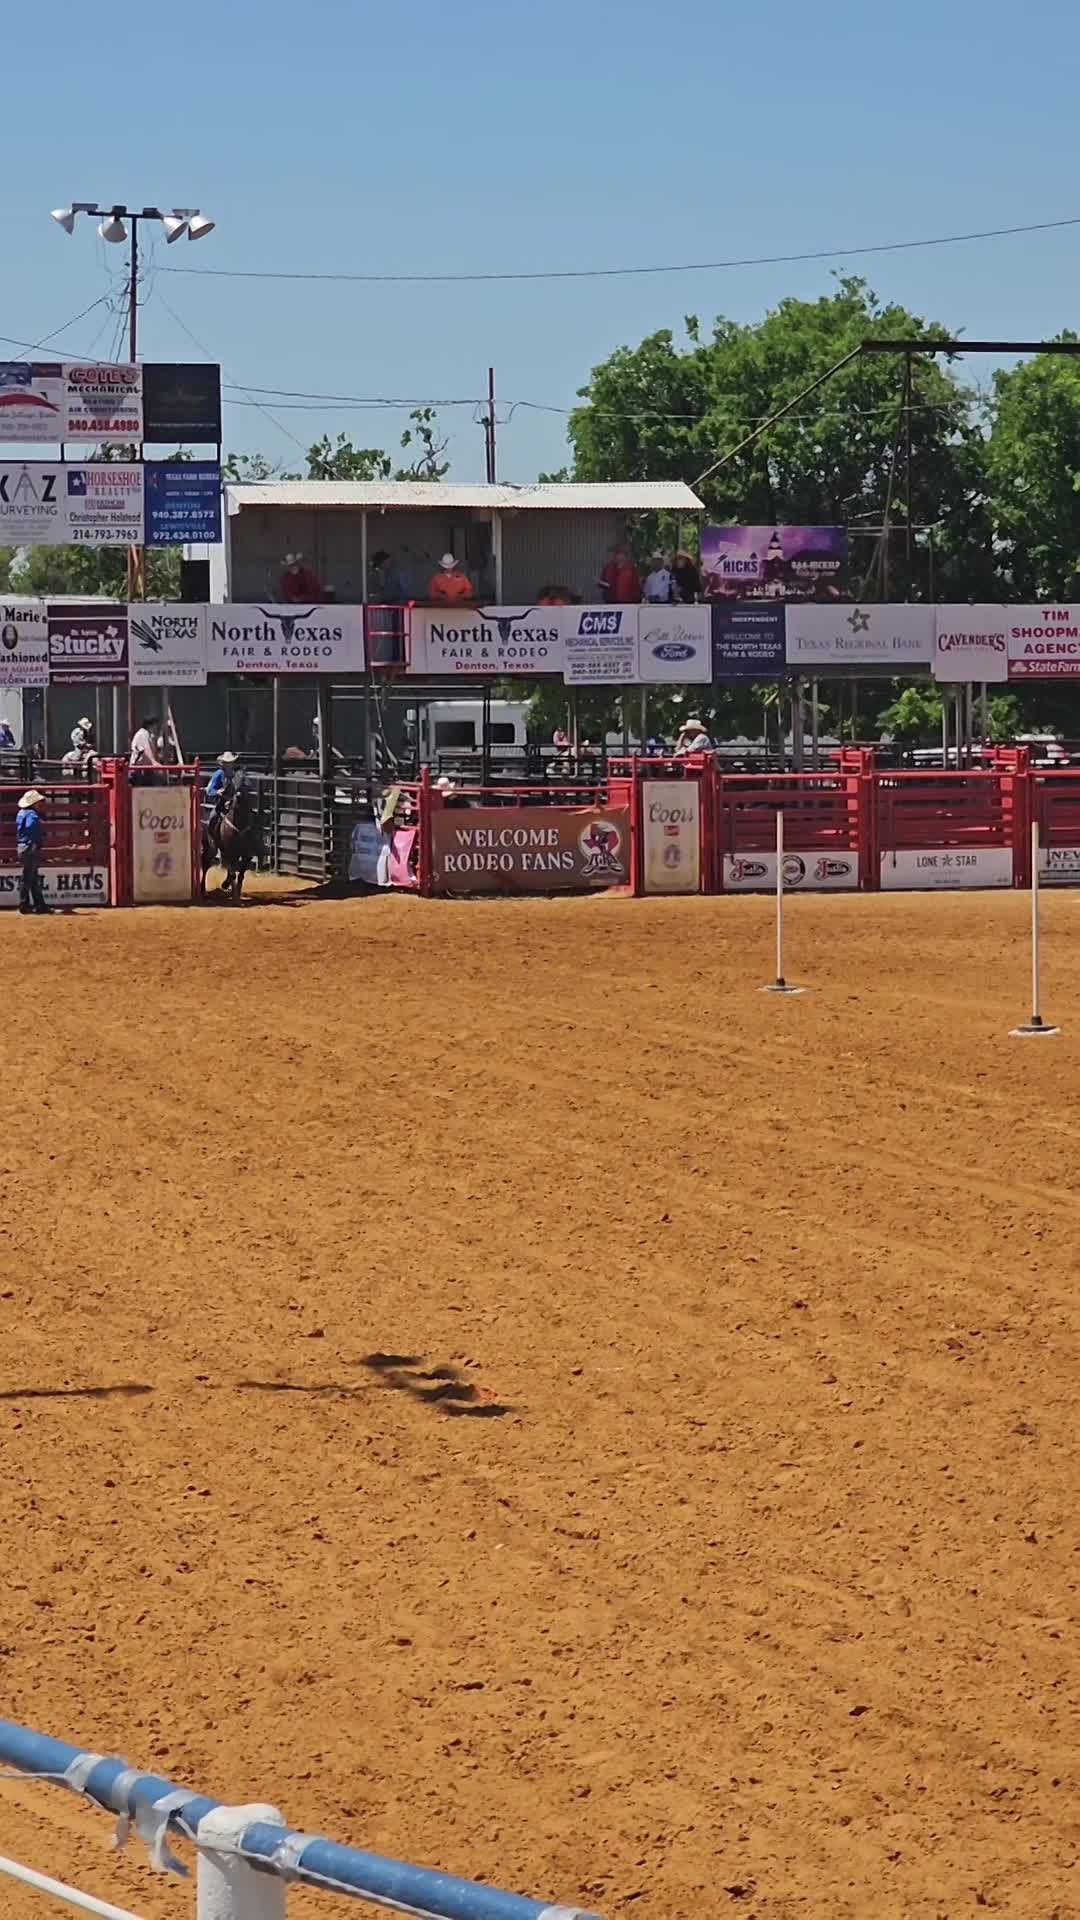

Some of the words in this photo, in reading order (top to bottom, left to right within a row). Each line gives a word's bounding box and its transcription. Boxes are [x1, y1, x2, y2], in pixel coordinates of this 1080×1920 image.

[67, 385, 141, 394] MECHANICAL
[87, 472, 141, 486] HORSESHOE
[0, 505, 57, 515] URVEYING
[73, 529, 138, 540] 214-793-7963
[723, 559, 758, 573] HICKS
[4, 606, 48, 623] Marie's
[1041, 610, 1070, 621] TIM
[151, 615, 198, 628] NORTH
[581, 616, 618, 631] CMS
[154, 628, 197, 640] TEXAS
[211, 621, 276, 642] North
[430, 623, 493, 643] North
[1011, 627, 1080, 638] SHOOPM
[50, 633, 125, 660] Stucky
[222, 647, 255, 657] FAIR
[263, 648, 272, 657] &
[281, 647, 333, 657] RODEO
[441, 647, 473, 658] FAIR
[481, 648, 489, 657] &
[497, 647, 549, 658] RODEO
[236, 660, 281, 670] Denton,
[286, 660, 319, 669] Texas
[455, 661, 498, 671] Denton,
[503, 661, 536, 670] Texas
[455, 828, 560, 847] WELCOME
[444, 852, 515, 872] RODEO
[521, 851, 575, 870] FANS
[916, 856, 939, 868] LONE
[956, 855, 977, 867] STAR
[56, 873, 104, 890] HATS
